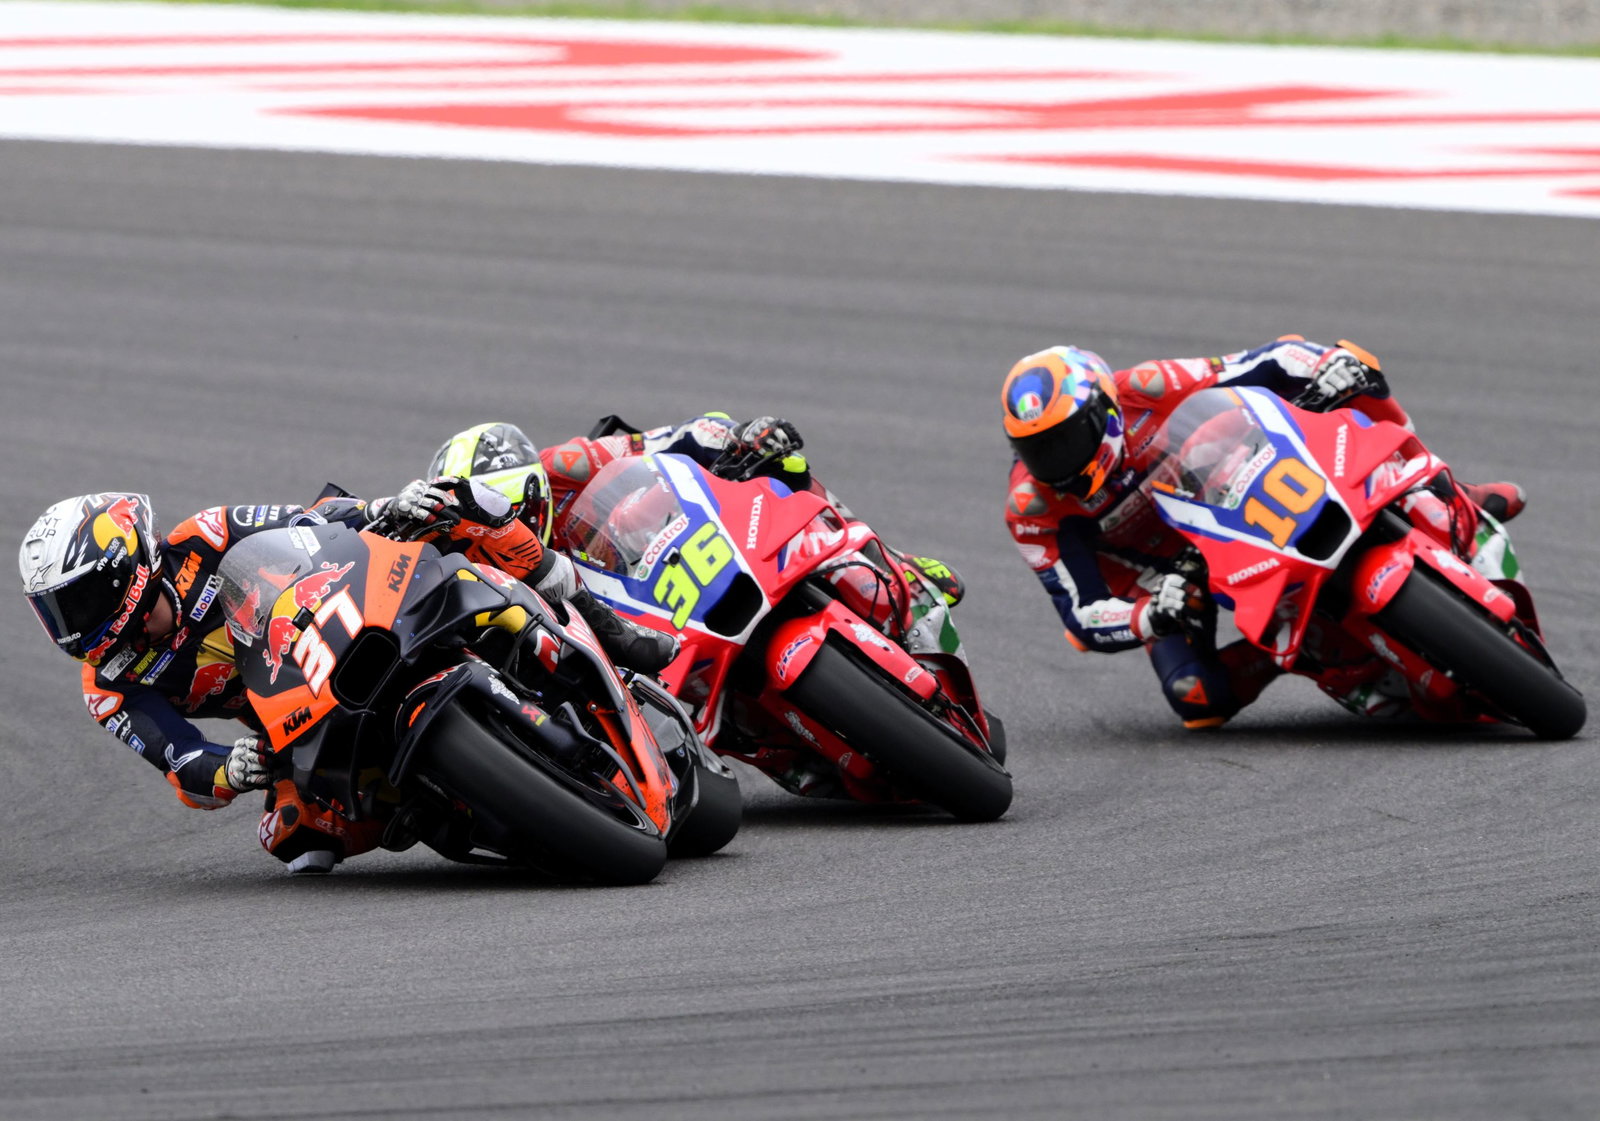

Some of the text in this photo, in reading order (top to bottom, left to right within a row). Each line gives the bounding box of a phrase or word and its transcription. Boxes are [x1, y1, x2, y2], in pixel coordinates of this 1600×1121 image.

[1235, 446, 1275, 494] Castrol
[1333, 423, 1348, 478] HONDA
[746, 493, 764, 550] HONDA
[1244, 456, 1327, 550] 10
[645, 517, 688, 565] Castrol
[174, 550, 203, 600] KTM
[387, 553, 412, 593] KTM
[652, 519, 736, 631] 36
[1227, 557, 1280, 585] HONDA
[109, 598, 137, 634] Red
[128, 563, 150, 603] Bull
[191, 588, 215, 619] Mobil
[292, 583, 366, 700] 37
[282, 705, 313, 737] KTM
